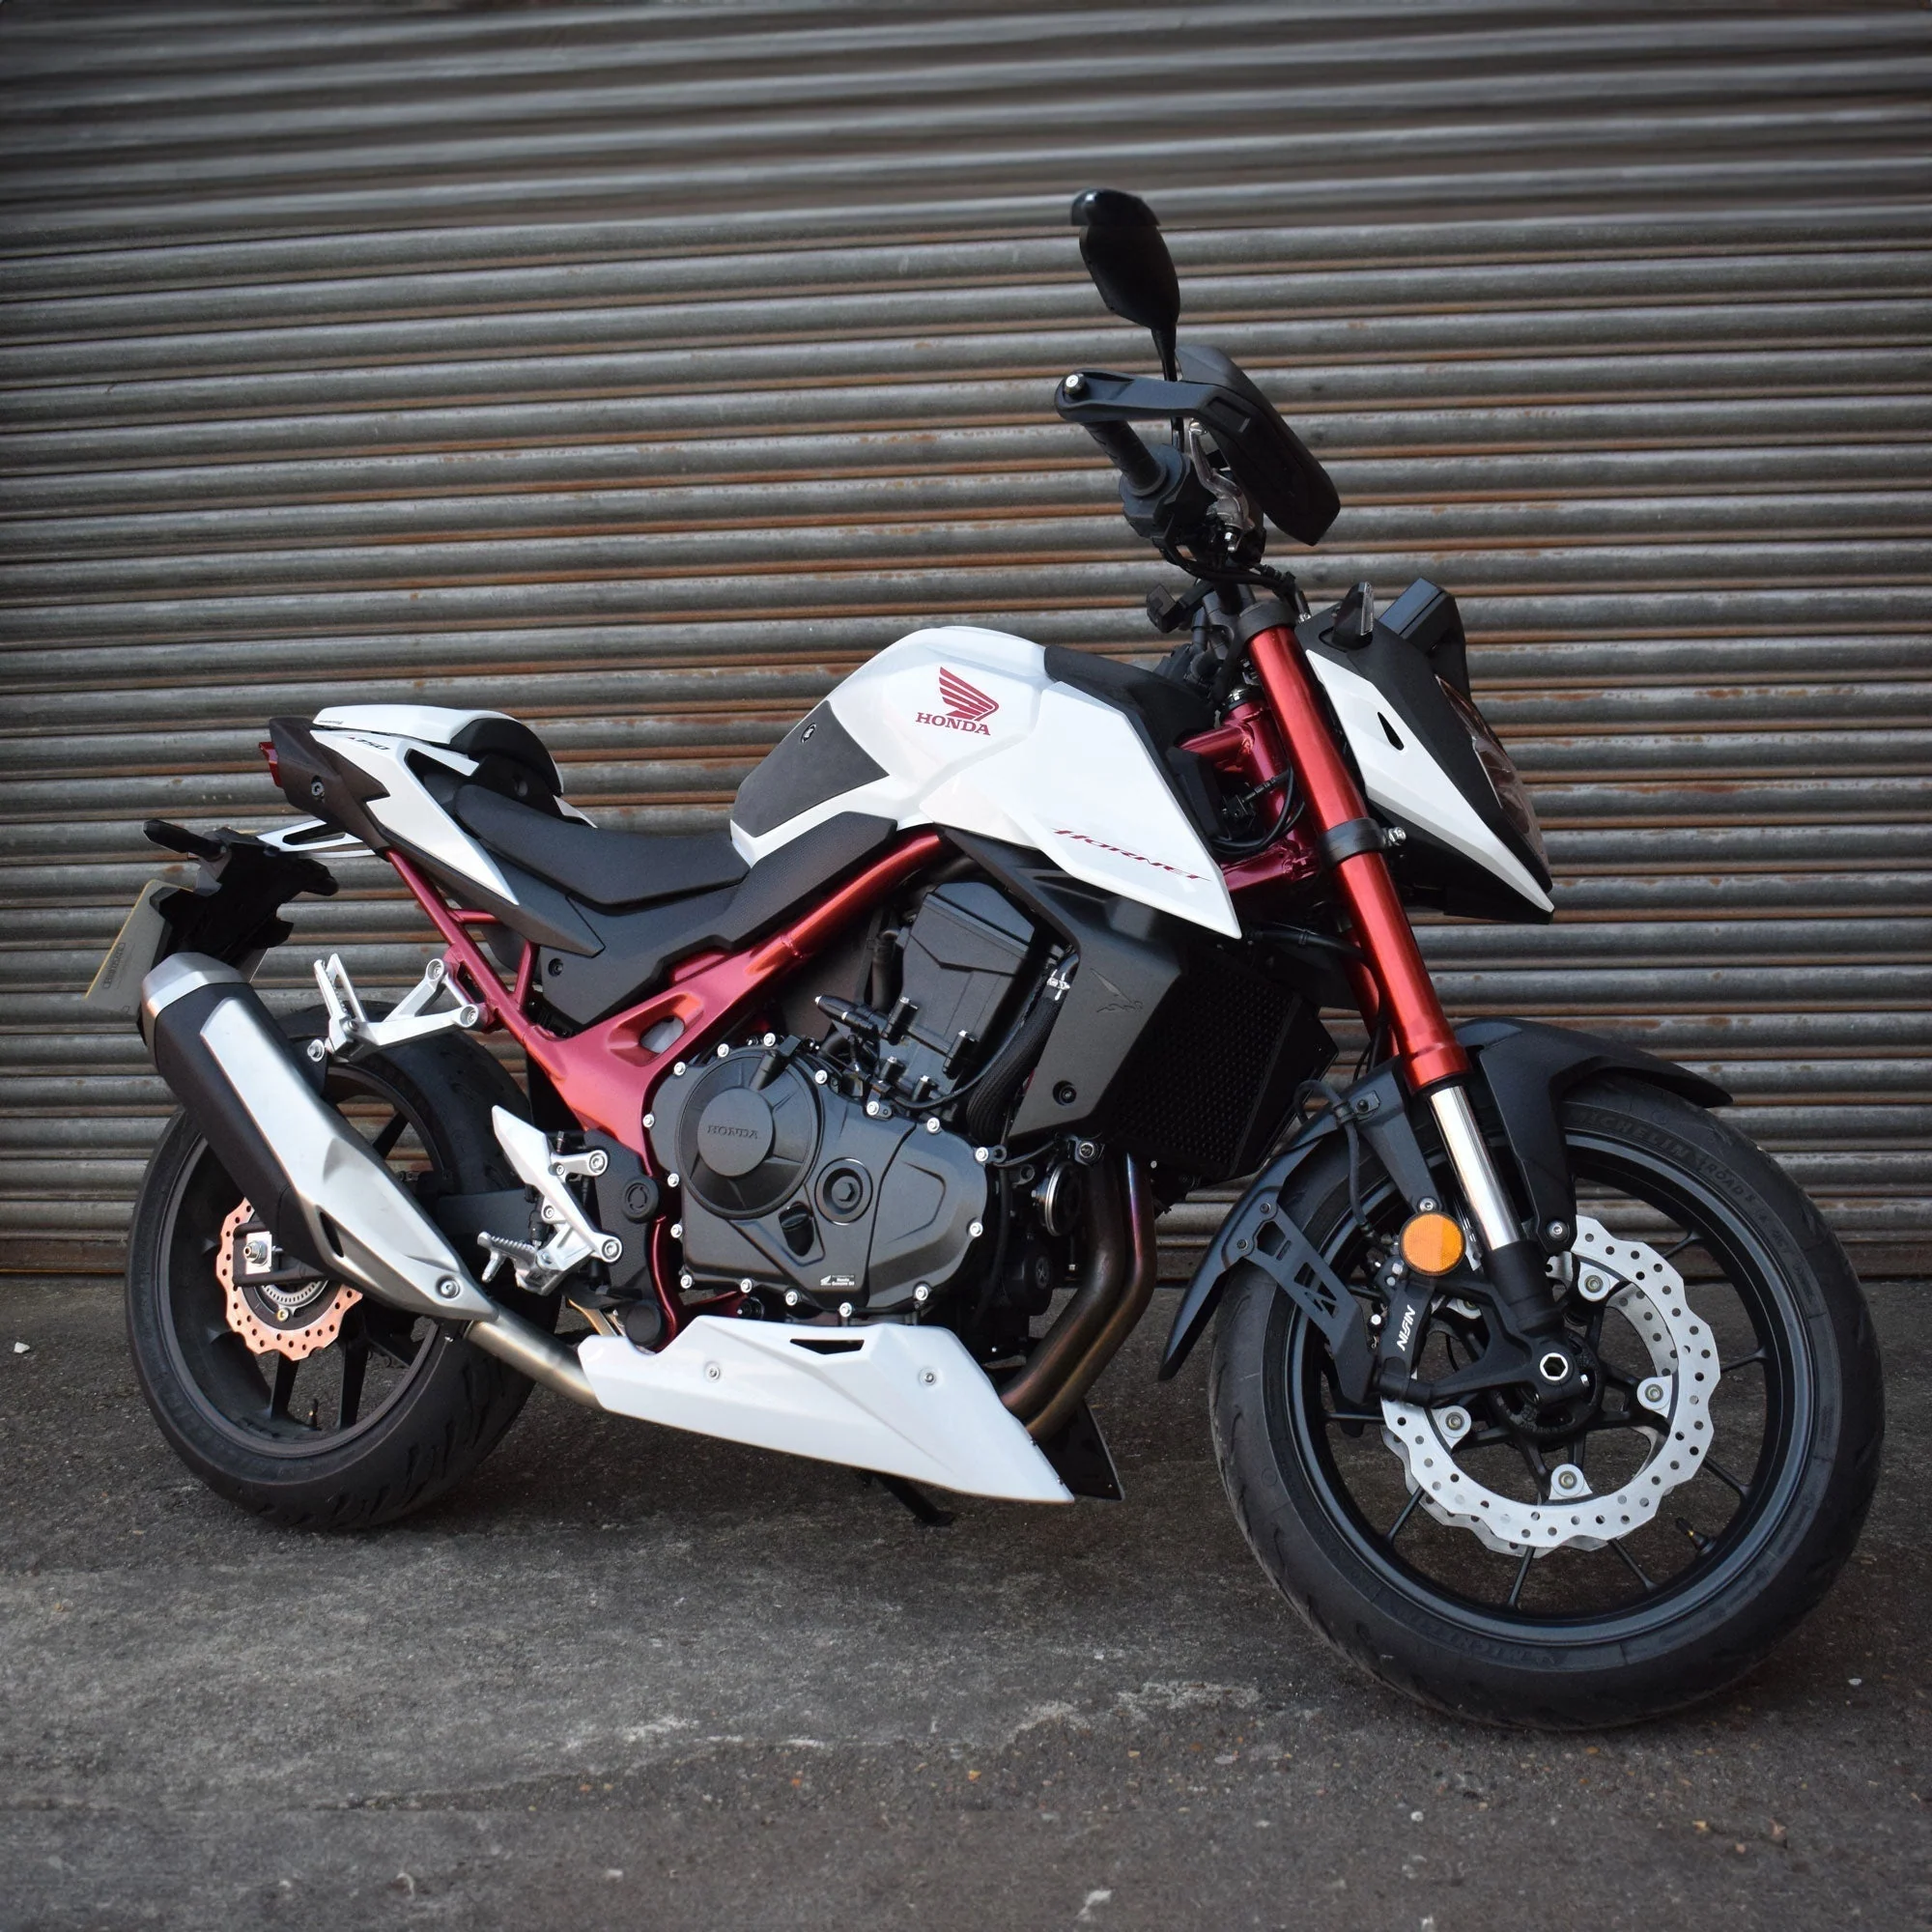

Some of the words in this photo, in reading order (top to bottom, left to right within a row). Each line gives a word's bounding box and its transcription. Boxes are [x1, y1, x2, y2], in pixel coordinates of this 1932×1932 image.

[916, 712, 991, 736] HONDA
[706, 1124, 759, 1140] HONDA
[1396, 1304, 1416, 1351] NISSIN
